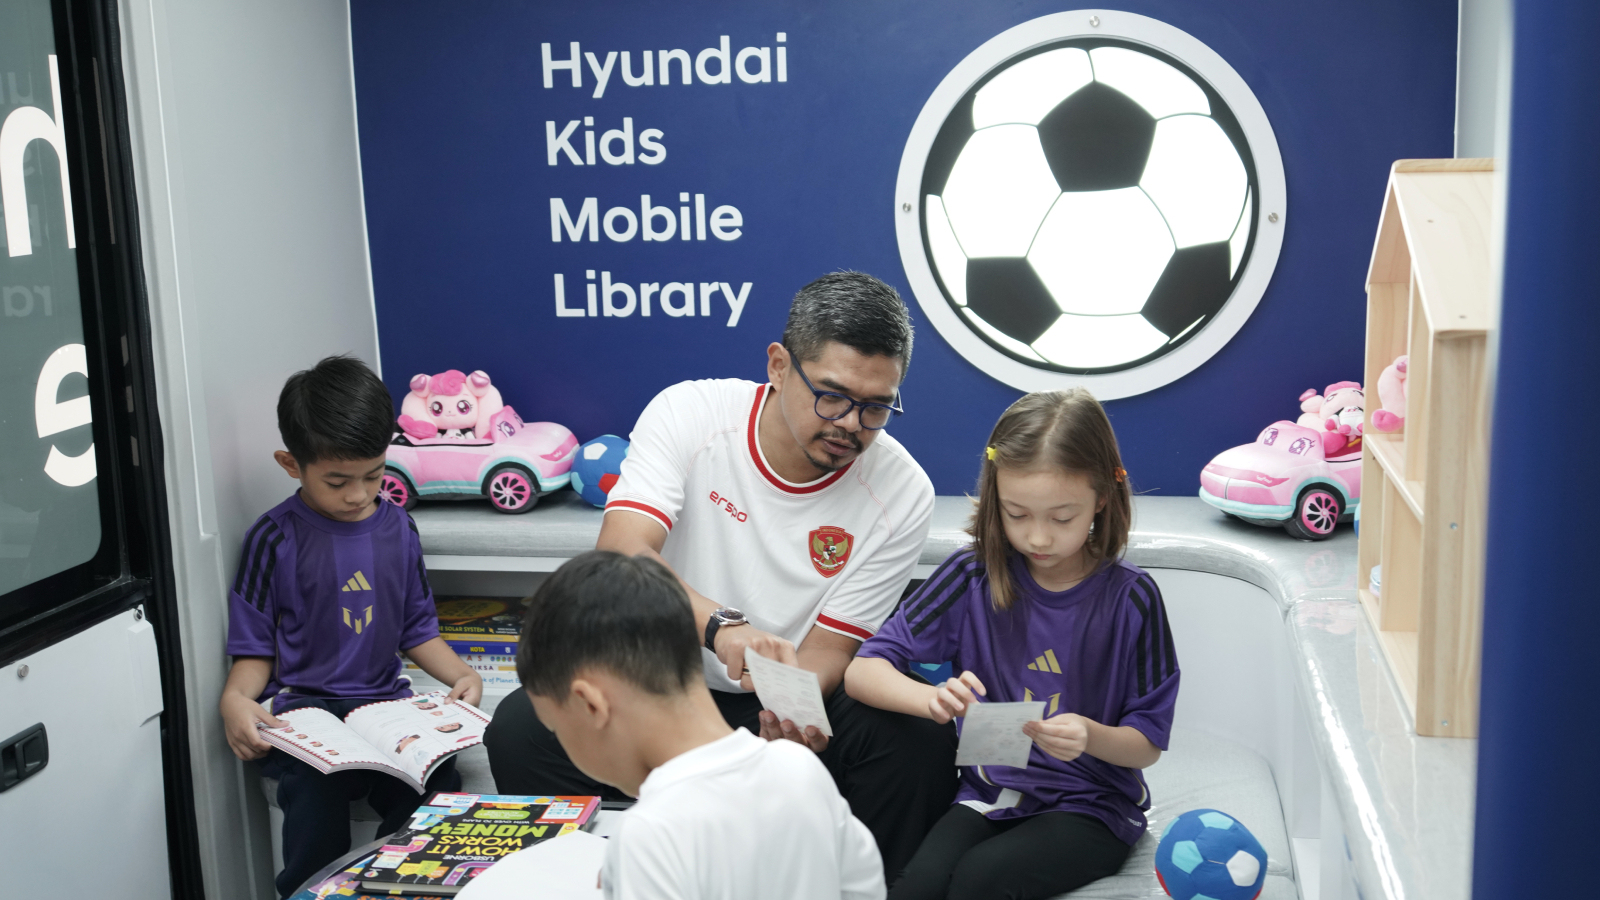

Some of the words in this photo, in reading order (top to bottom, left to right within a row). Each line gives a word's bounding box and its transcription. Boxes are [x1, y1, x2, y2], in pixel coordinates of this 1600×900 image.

[541, 32, 787, 98] Hyundai
[546, 116, 667, 166] Kids
[550, 192, 743, 242] Mobile
[554, 269, 753, 327] Library
[709, 490, 748, 523] erspo
[430, 823, 550, 838] MONEY
[438, 835, 523, 847] WORKS
[427, 845, 449, 855] IT
[442, 854, 495, 862] USBORNE
[456, 846, 521, 857] HOW
